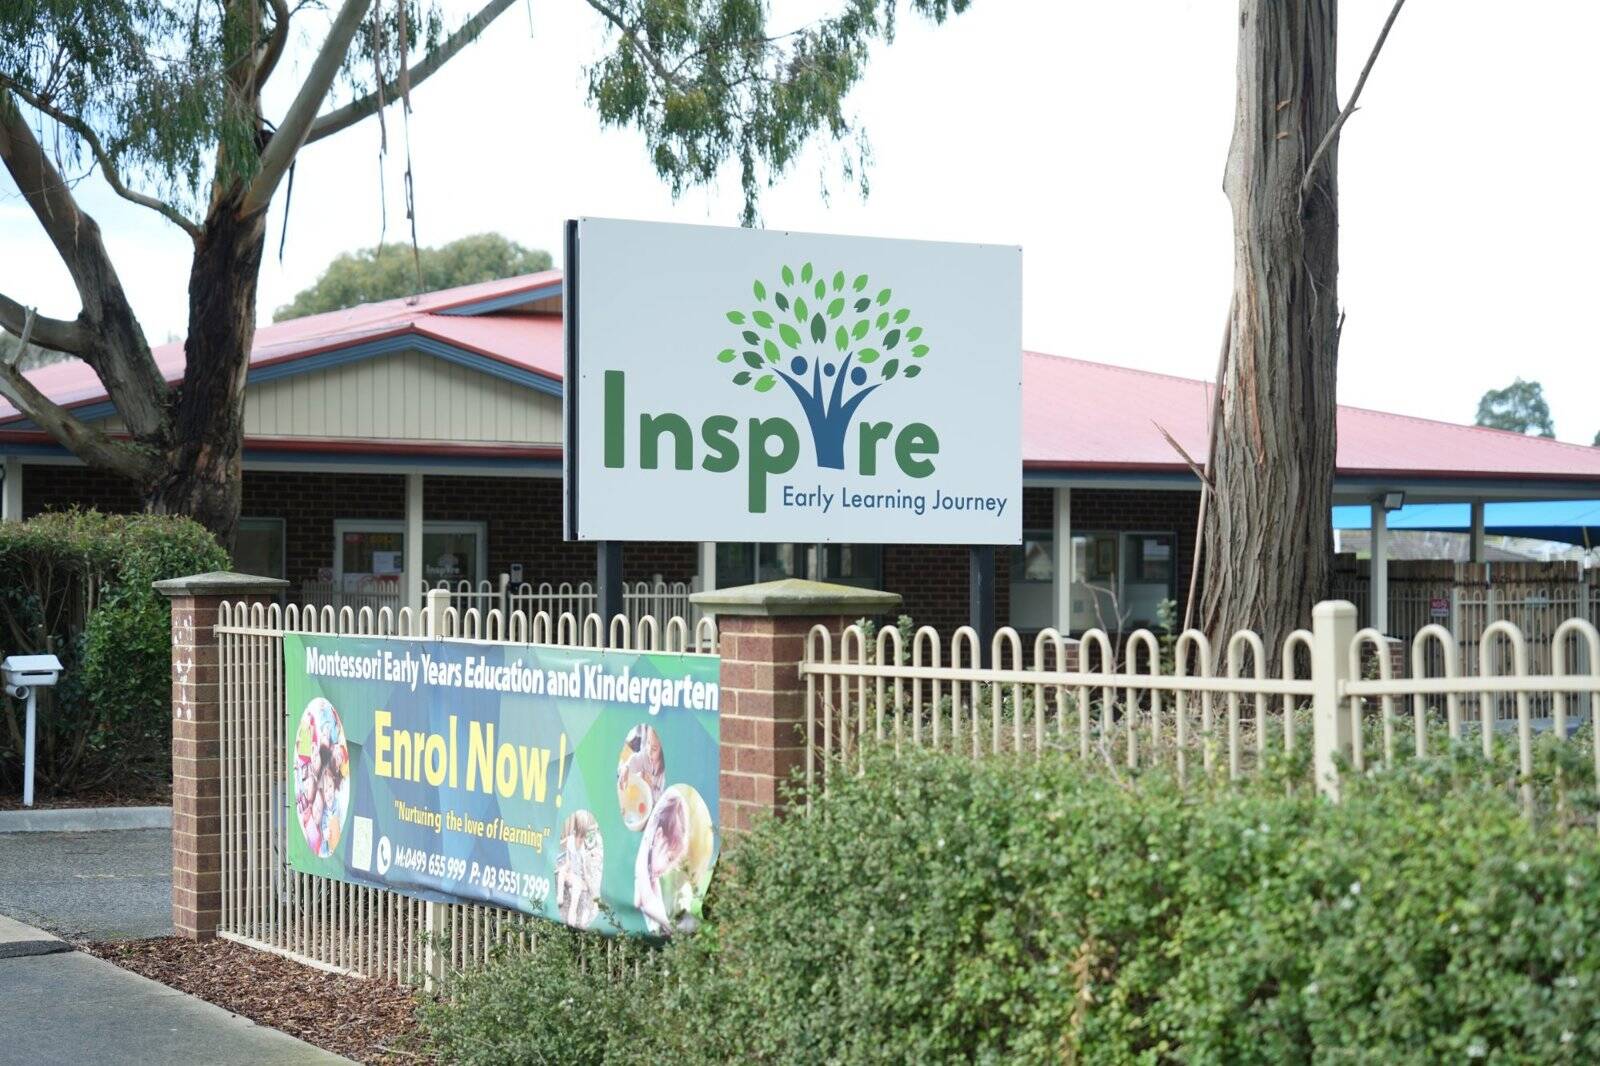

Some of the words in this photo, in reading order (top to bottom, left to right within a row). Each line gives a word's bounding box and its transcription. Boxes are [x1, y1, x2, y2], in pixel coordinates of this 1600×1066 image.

[783, 485, 834, 513] Early
[842, 487, 926, 515] Learning
[932, 489, 1008, 517] Journey
[306, 646, 382, 681] Montessori
[384, 650, 420, 692] Early
[421, 653, 462, 688] Years
[464, 655, 544, 694] Education
[547, 662, 582, 699] and
[583, 664, 719, 716] Kindergarten
[374, 710, 458, 789] Enrol
[446, 810, 463, 832] the
[464, 812, 485, 838] love
[486, 817, 499, 840] of
[428, 852, 446, 877] 655
[446, 856, 467, 882] 999
[481, 864, 497, 889] 03
[497, 868, 521, 895] 9551
[521, 873, 551, 902] 2999
